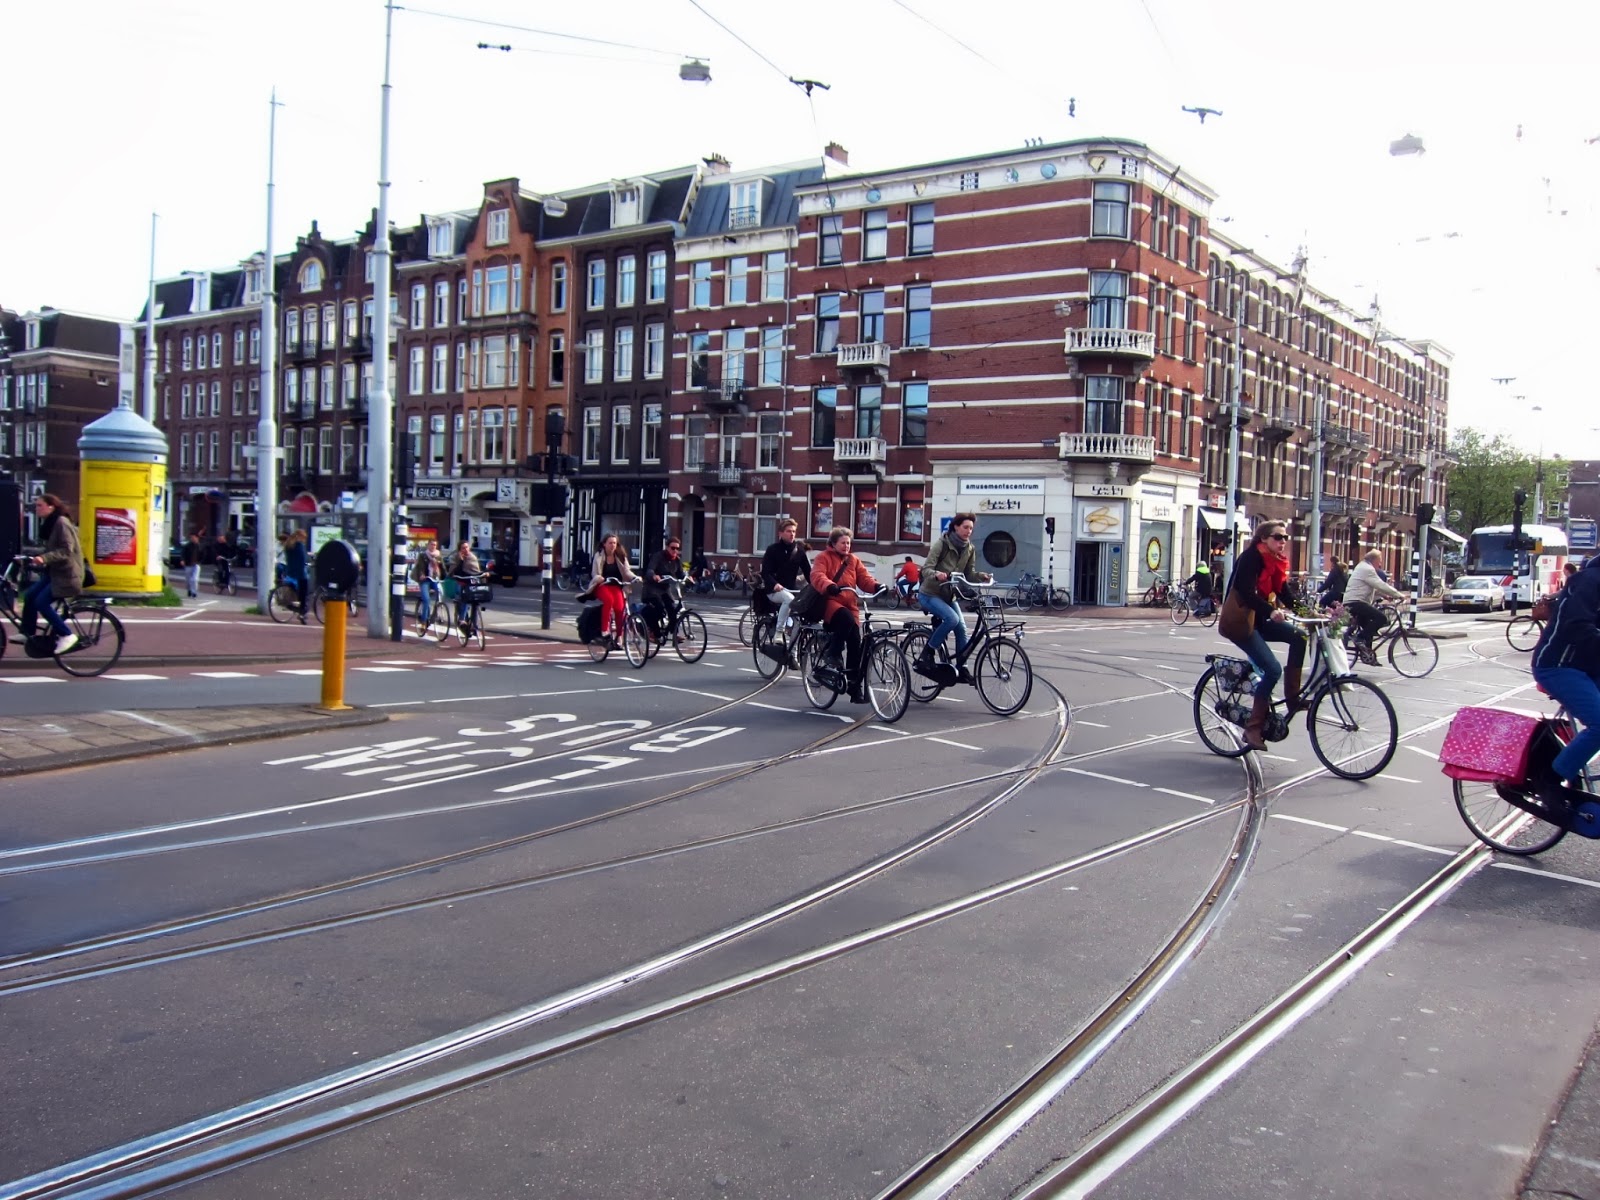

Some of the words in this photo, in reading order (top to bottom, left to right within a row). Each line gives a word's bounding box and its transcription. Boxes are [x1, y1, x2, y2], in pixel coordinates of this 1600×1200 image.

[417, 488, 440, 498] GILEX
[1109, 558, 1119, 589] Entree
[458, 713, 747, 753] BUS
